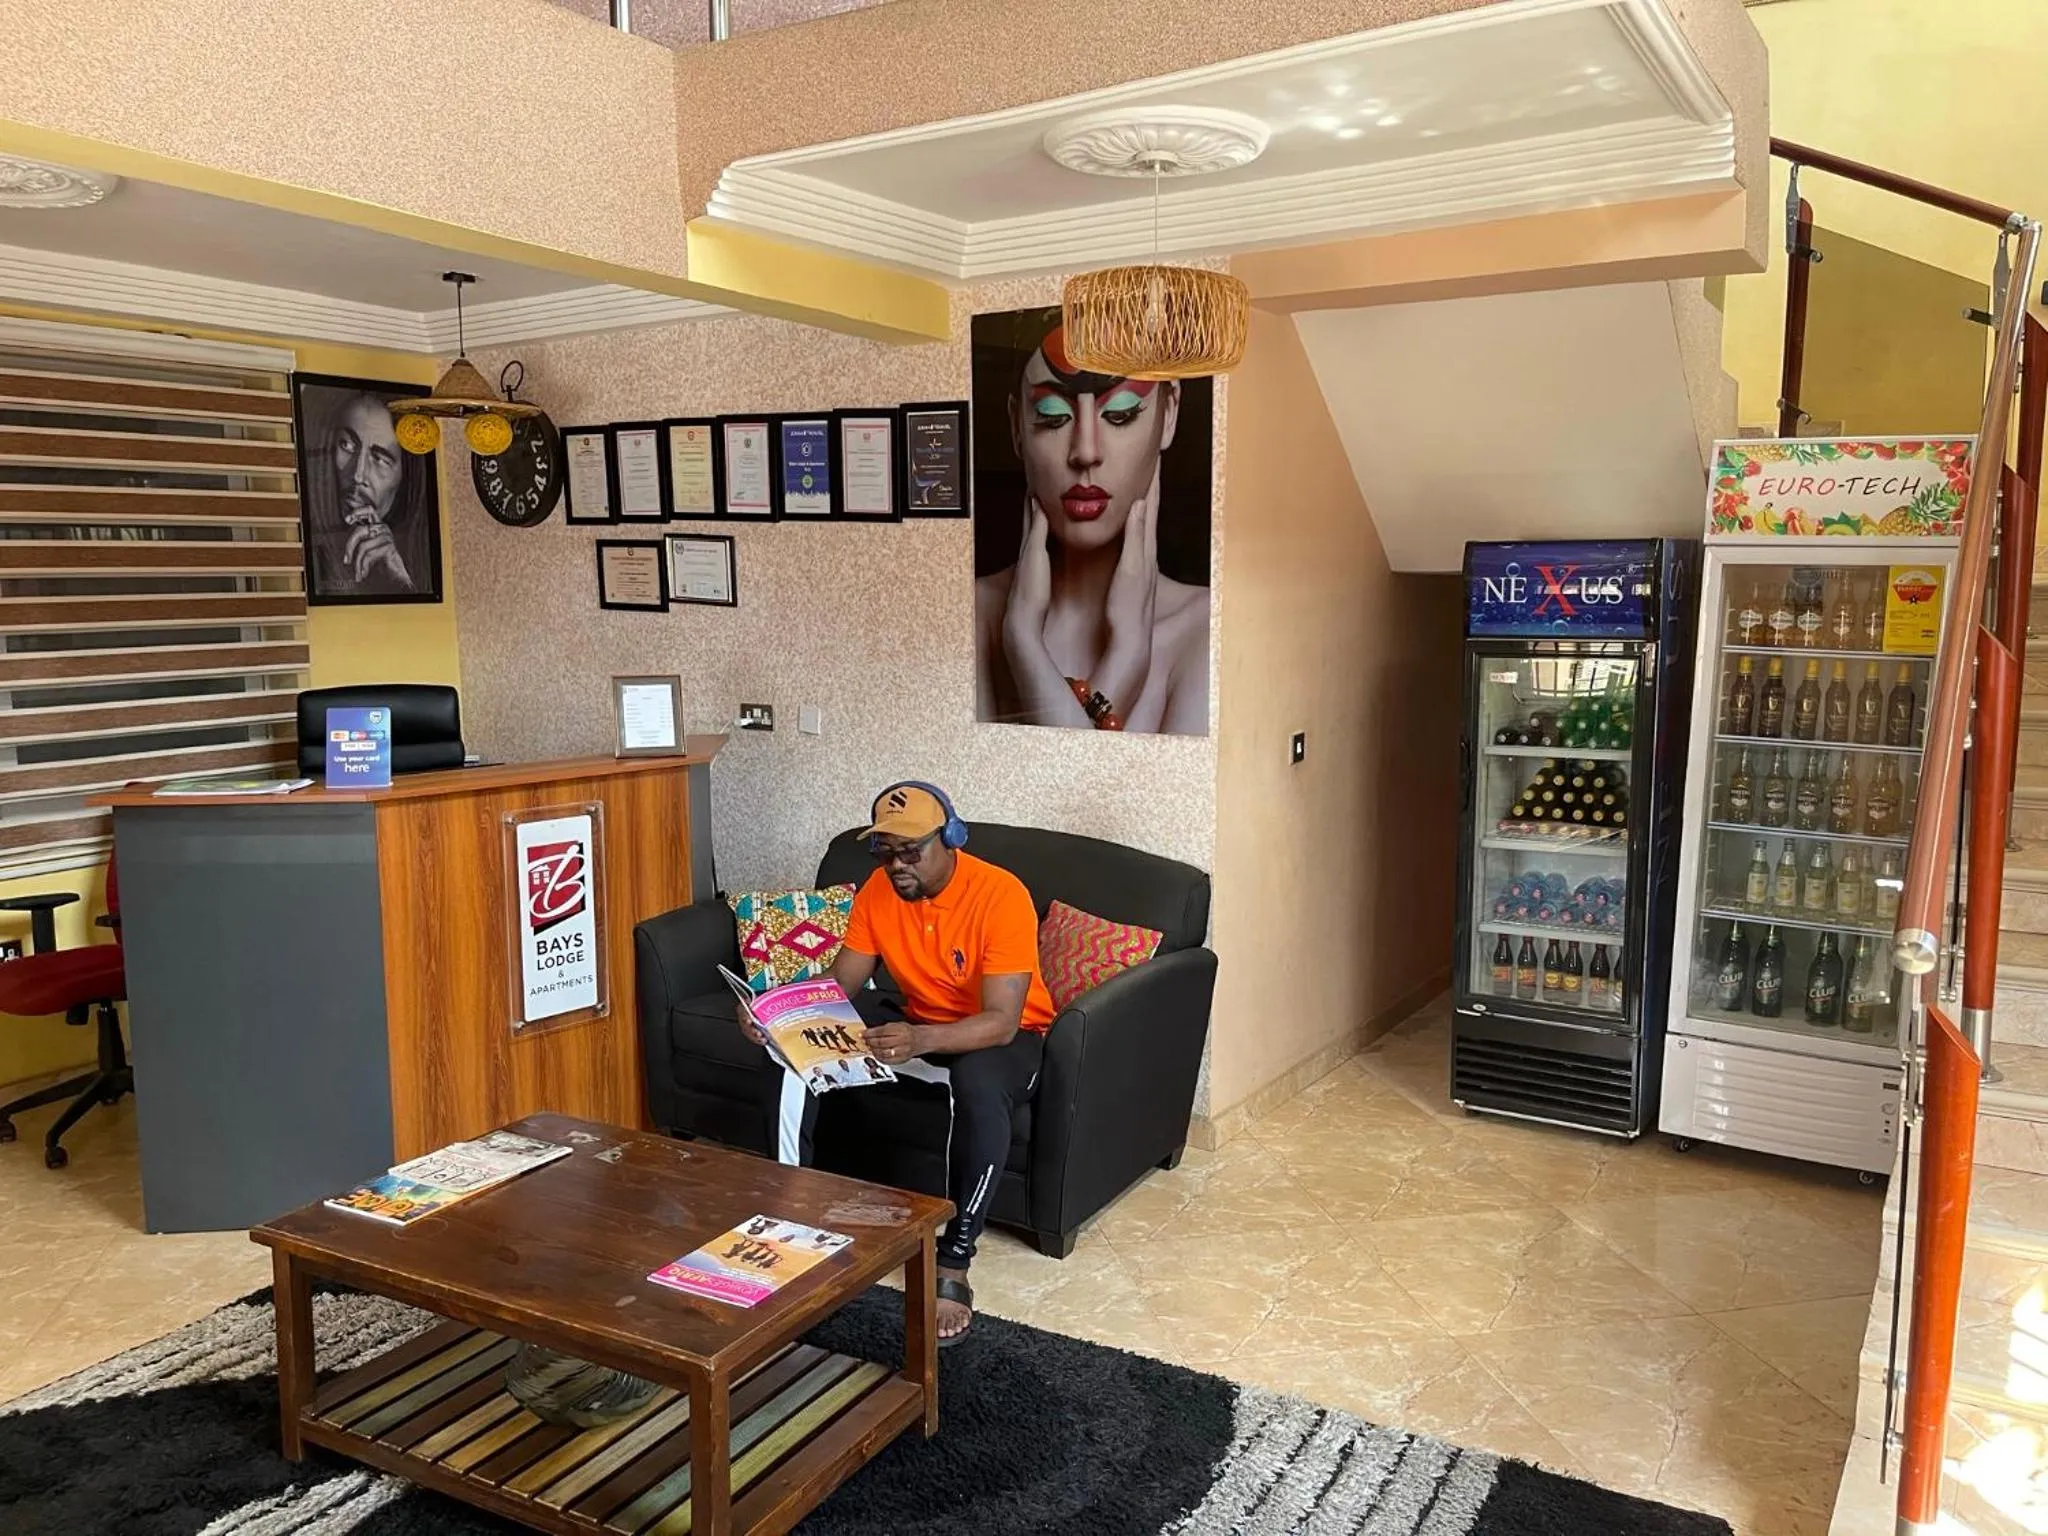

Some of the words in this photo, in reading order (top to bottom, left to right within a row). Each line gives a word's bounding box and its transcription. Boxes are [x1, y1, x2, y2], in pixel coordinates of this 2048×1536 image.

[531, 439, 544, 453] 2
[485, 460, 498, 474] 9
[536, 456, 547, 470] 3
[489, 478, 502, 496] 8
[535, 474, 547, 492] 4
[1758, 476, 1922, 497] EURO-TECH
[526, 487, 539, 509] 5
[1482, 564, 1624, 616] NEXUS
[344, 763, 370, 773] here
[536, 933, 584, 956] BAYS
[537, 950, 585, 971] LODGE
[558, 969, 565, 979] &
[530, 974, 594, 996] APARTMENTS
